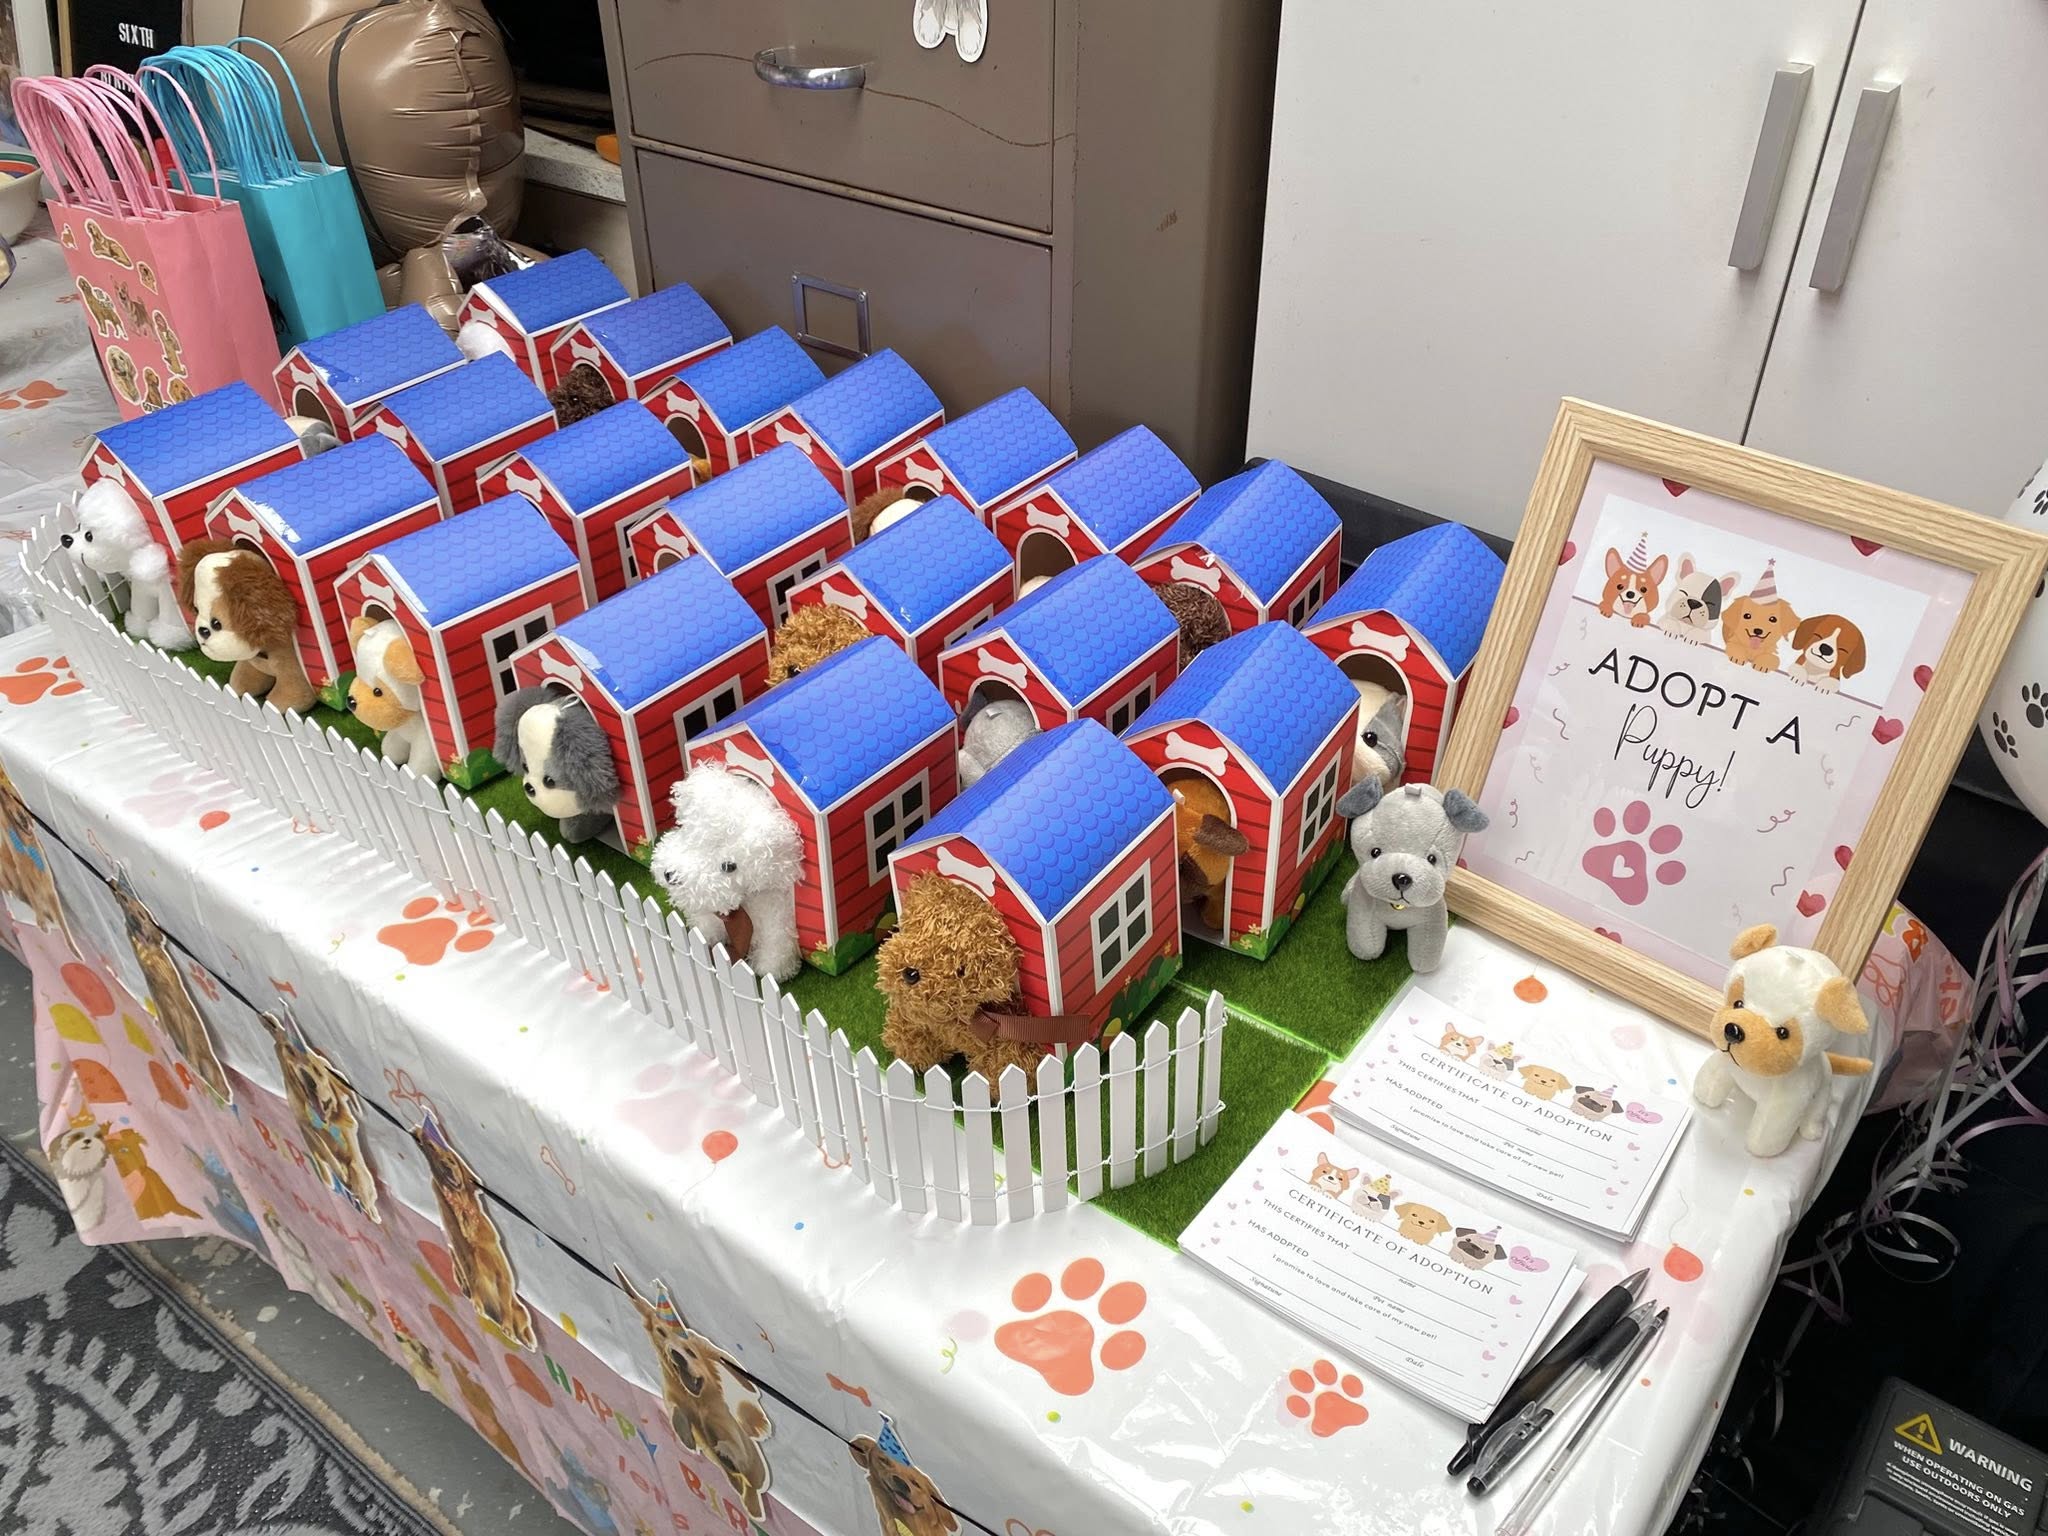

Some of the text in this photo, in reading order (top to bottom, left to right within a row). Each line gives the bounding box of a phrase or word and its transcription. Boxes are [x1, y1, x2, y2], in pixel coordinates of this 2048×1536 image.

[118, 22, 154, 49] SIXTH
[1588, 647, 1801, 755] ADOPT A
[1613, 703, 1736, 809] Puppy!
[1385, 1077, 1403, 1089] HAS
[1398, 1060, 1480, 1104] THIS CERTIFIES THAT
[1421, 1053, 1613, 1142] CERTIFICATE OF ADOPTION
[1413, 1108, 1441, 1124] promise
[1450, 1125, 1464, 1135] love
[1464, 1133, 1480, 1142] and
[1480, 1140, 1495, 1149] take
[1248, 1219, 1267, 1233] HAS
[1263, 1198, 1350, 1250] THIS CERTIFIES THAT
[1289, 1189, 1493, 1294] CERTIFICATE OF ADOPTION
[1275, 1256, 1305, 1275] promise
[1306, 1272, 1313, 1280] to
[1315, 1277, 1330, 1288] love
[1331, 1287, 1347, 1297] and
[1347, 1294, 1363, 1305] take
[1364, 1304, 1381, 1314] care
[1391, 1316, 1403, 1325] my
[1404, 1322, 1420, 1332] new
[1893, 1440, 2025, 1517] WHEN OPERATING ON GAS
[1902, 1456, 2011, 1519] USE OUTDOORS ONLY
[1949, 1438, 2033, 1493] WARNING
